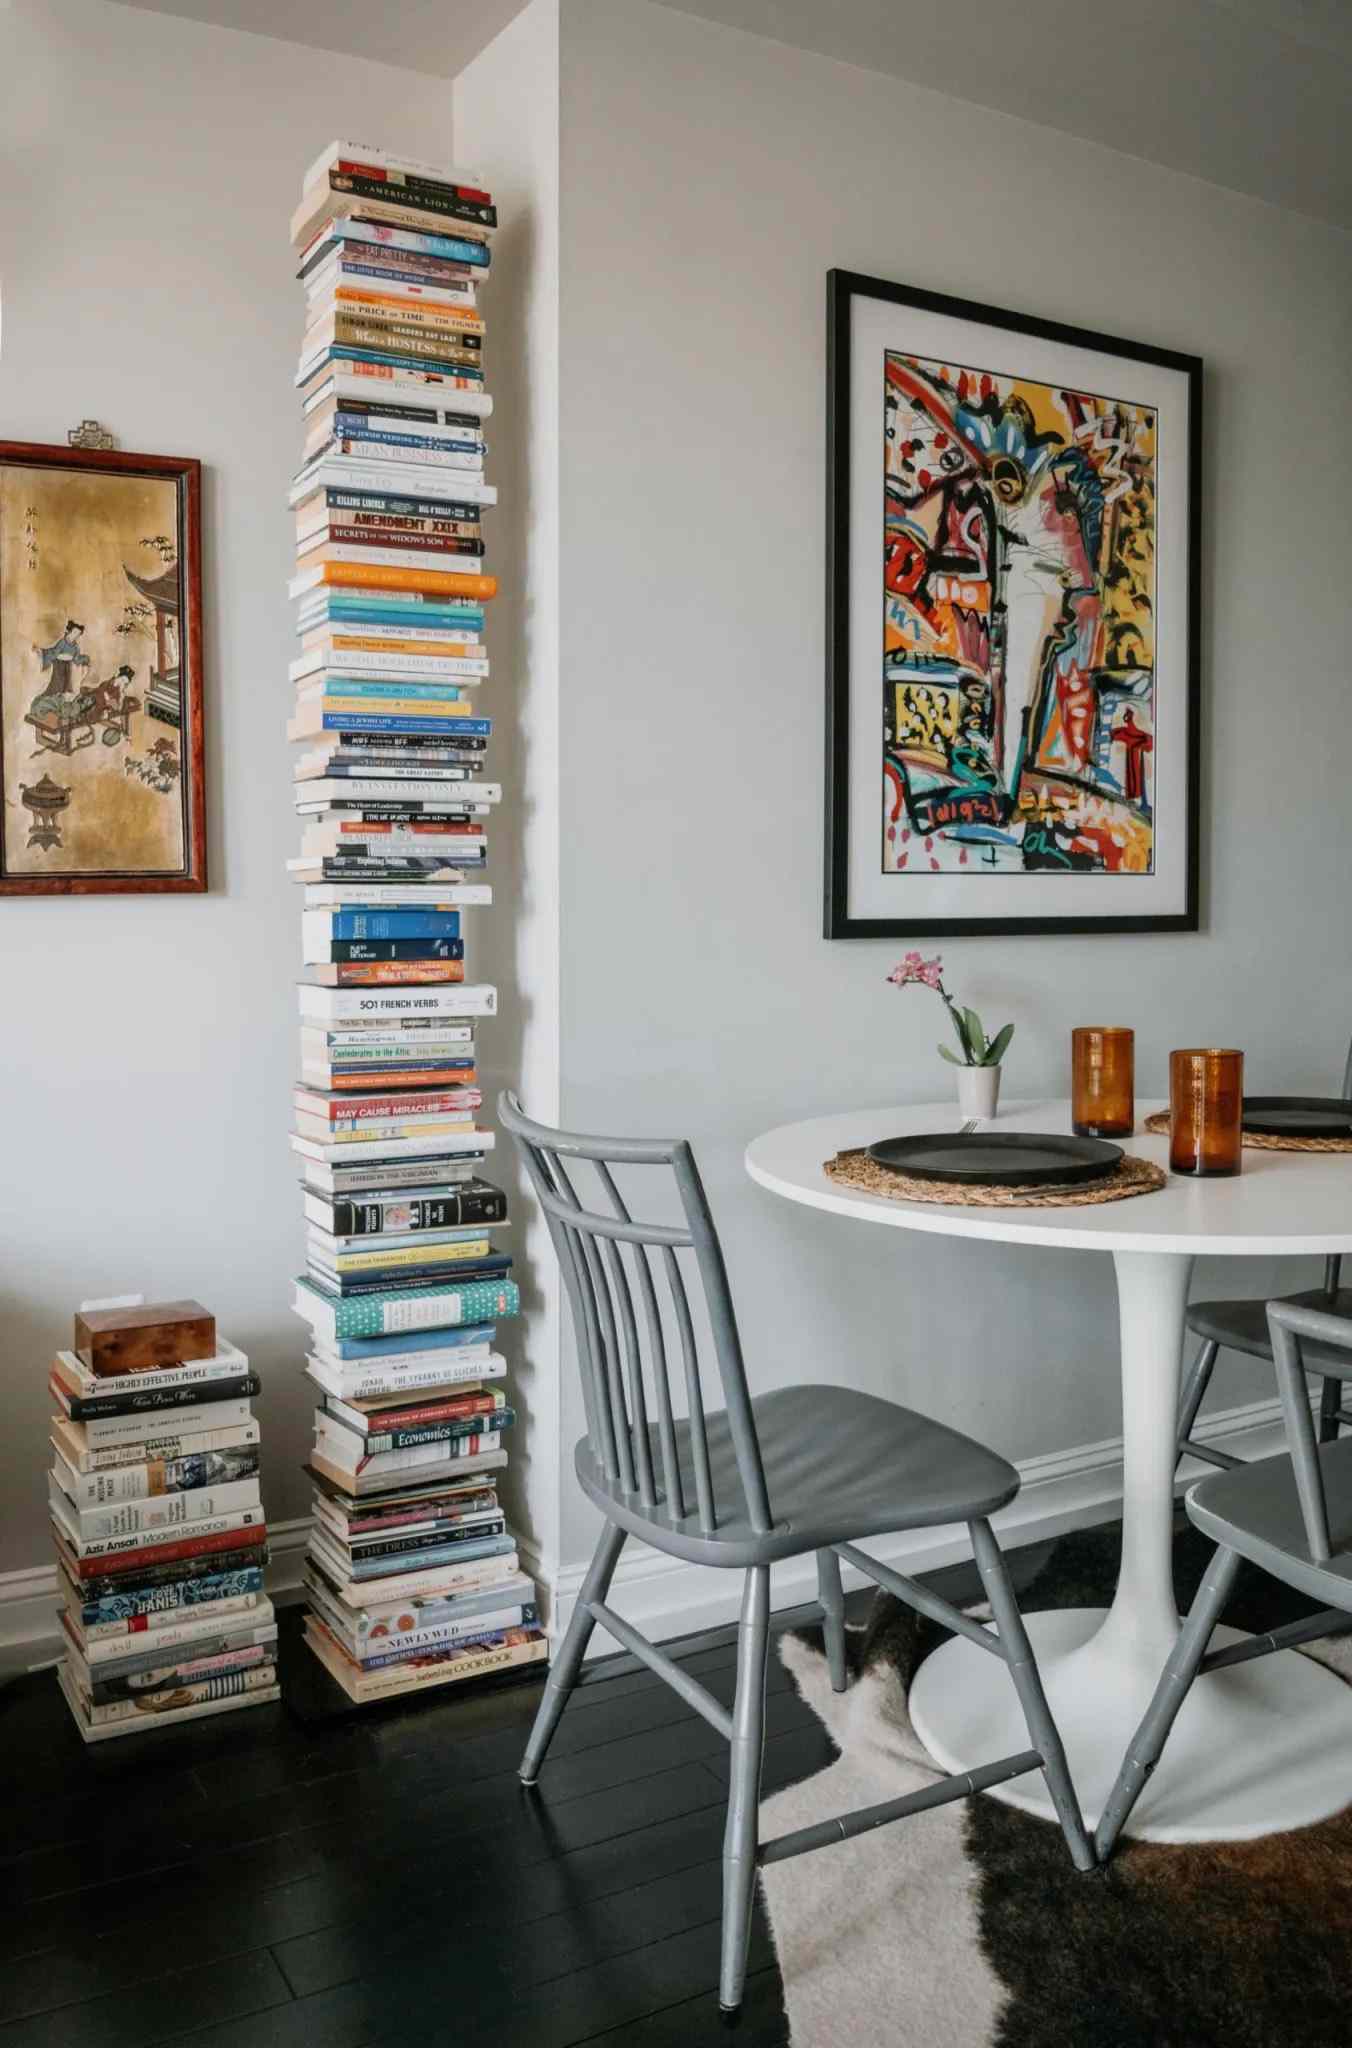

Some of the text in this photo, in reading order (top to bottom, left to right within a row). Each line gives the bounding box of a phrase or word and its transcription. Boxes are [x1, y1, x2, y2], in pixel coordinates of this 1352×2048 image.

[370, 186, 449, 210] AMERICAN LION
[358, 306, 386, 317] PRICE
[401, 312, 425, 322] TIME
[353, 513, 459, 535] AMENDMENT XXIX
[334, 528, 369, 541] SECRETS
[427, 537, 444, 547] SON
[359, 997, 439, 1010] 501 FRENCH VERBS
[333, 1048, 373, 1059] Confederates
[383, 1048, 393, 1057] the
[336, 1109, 358, 1120] MAY
[359, 1107, 390, 1118] CAUSE
[114, 1378, 141, 1391] HIGHLY
[142, 1373, 181, 1387] EFFECTIVE
[181, 1368, 208, 1381] PEOPLE
[399, 1426, 451, 1447] Economics
[85, 1519, 228, 1556] Aziz Ansari Modern Romance
[360, 1546, 383, 1558] THE
[136, 1595, 178, 1614] JANIS
[386, 1625, 461, 1650] NEWLYWED
[453, 1652, 514, 1675] COOKBOOK
